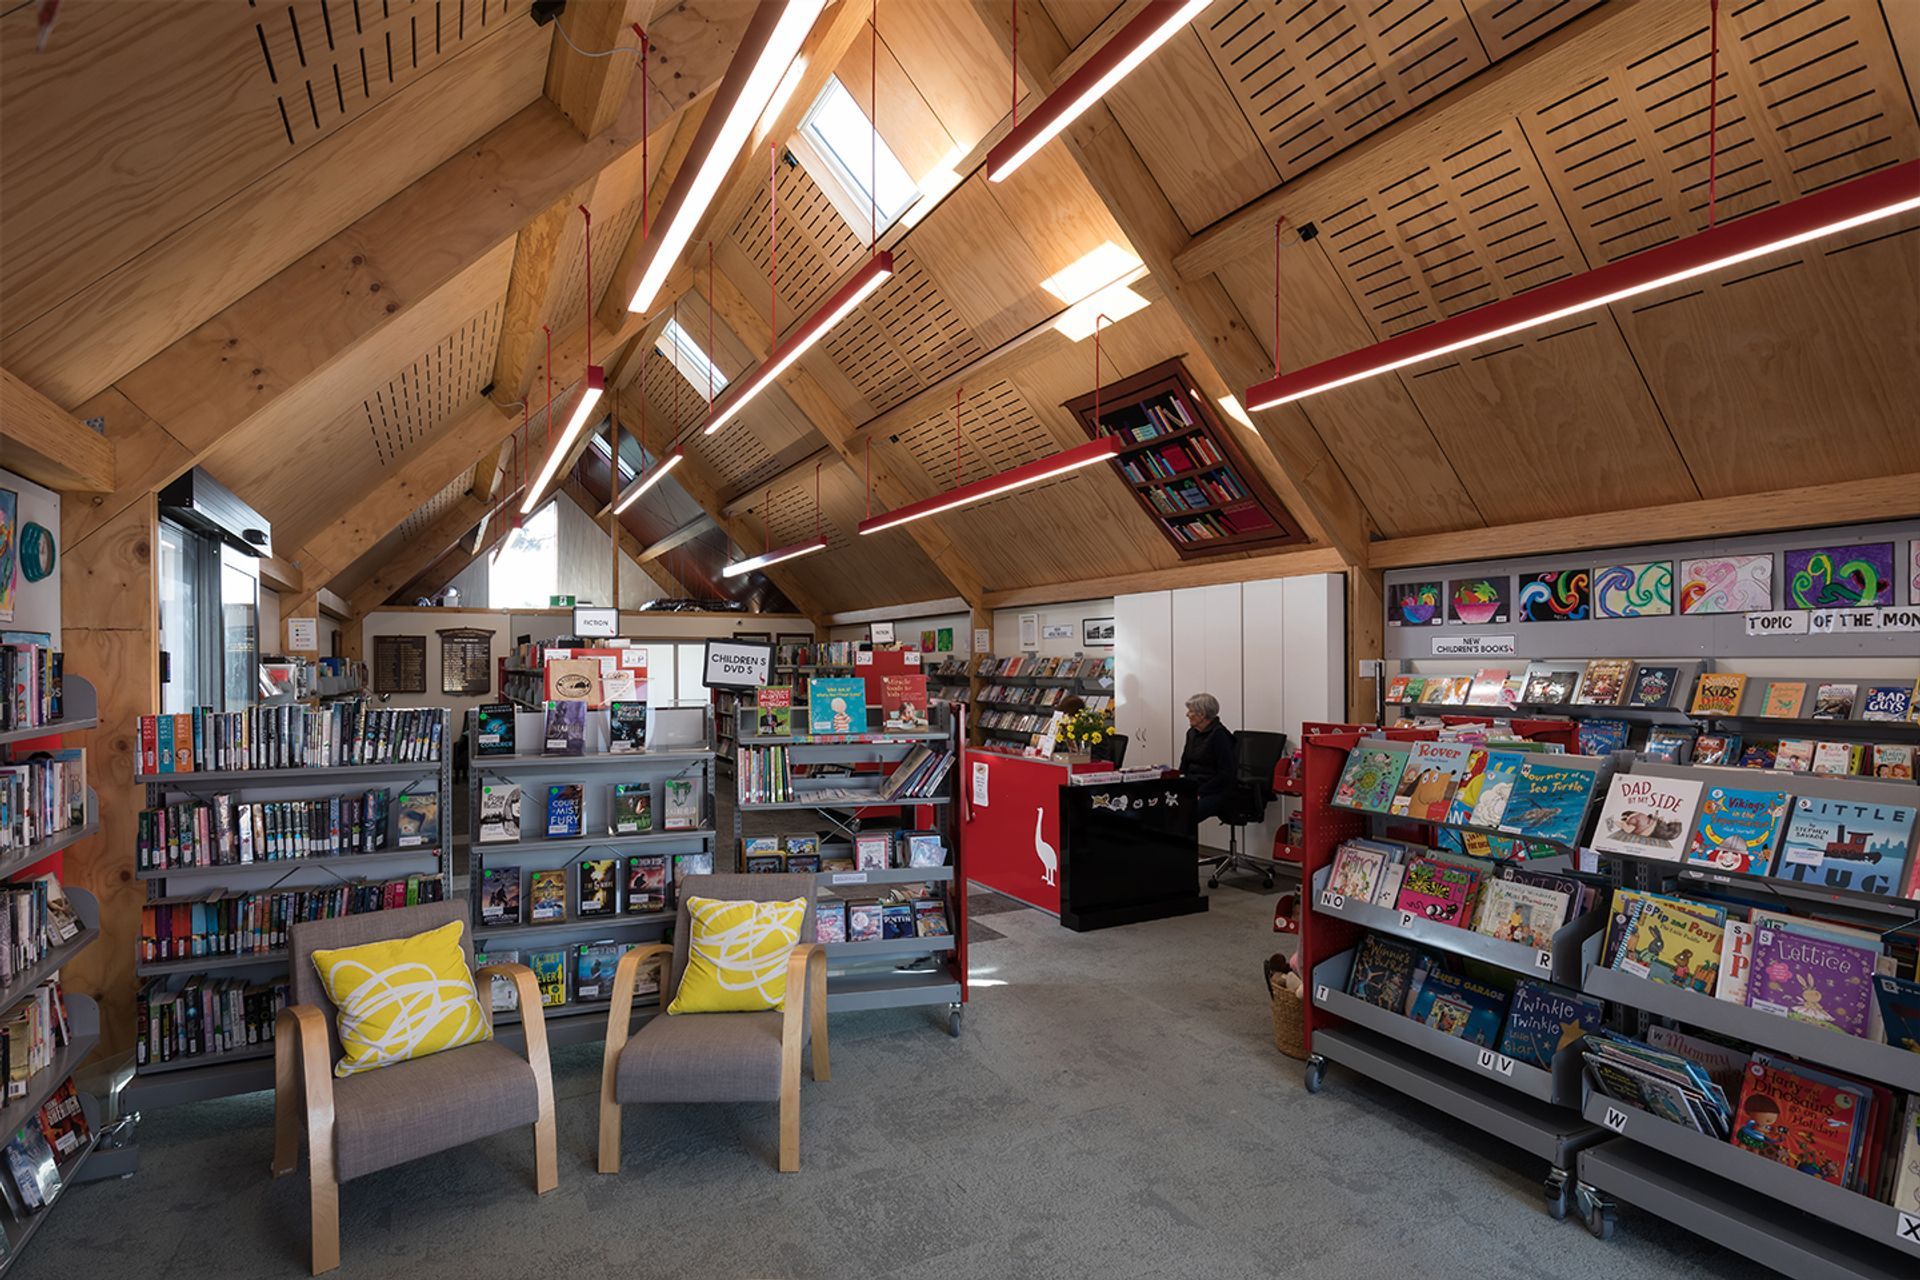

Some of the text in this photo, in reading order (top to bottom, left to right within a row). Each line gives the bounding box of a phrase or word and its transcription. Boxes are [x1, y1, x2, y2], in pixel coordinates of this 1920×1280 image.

[1748, 612, 1920, 629] TOPIC OF THE MON
[1436, 645, 1479, 653] CHILDREN'S
[1877, 692, 1906, 702] BAD
[1869, 700, 1905, 712] GUYS
[1418, 744, 1461, 758] Rover
[1530, 782, 1583, 794] Sea Turtle
[1621, 781, 1651, 797] DAD
[1628, 796, 1637, 805] BY
[1648, 792, 1684, 813] SIDE
[1728, 797, 1765, 810] Vikings
[550, 816, 580, 825] FURY
[1794, 826, 1830, 835] STEPHEN
[1795, 832, 1824, 840] SAVAGE
[1785, 863, 1889, 895] TUG
[1323, 893, 1331, 904] N
[1333, 896, 1343, 907] O
[1402, 914, 1411, 925] P
[1652, 906, 1716, 942] Pip and Posy
[1734, 926, 1742, 934] S
[1761, 933, 1769, 942] S
[1540, 953, 1550, 967] R
[1777, 940, 1851, 974] Lettice
[1319, 987, 1326, 998] T
[1518, 993, 1574, 1018] Twinkle
[1512, 1014, 1560, 1035] Twinkle
[1482, 1054, 1491, 1066] U
[1501, 1058, 1512, 1071] V
[1762, 1071, 1803, 1093] Harry
[1752, 1079, 1834, 1117] Dinosaurs
[1610, 1109, 1626, 1127] W
[1792, 1114, 1839, 1137] Holiday!
[1903, 1217, 1920, 1240] X
